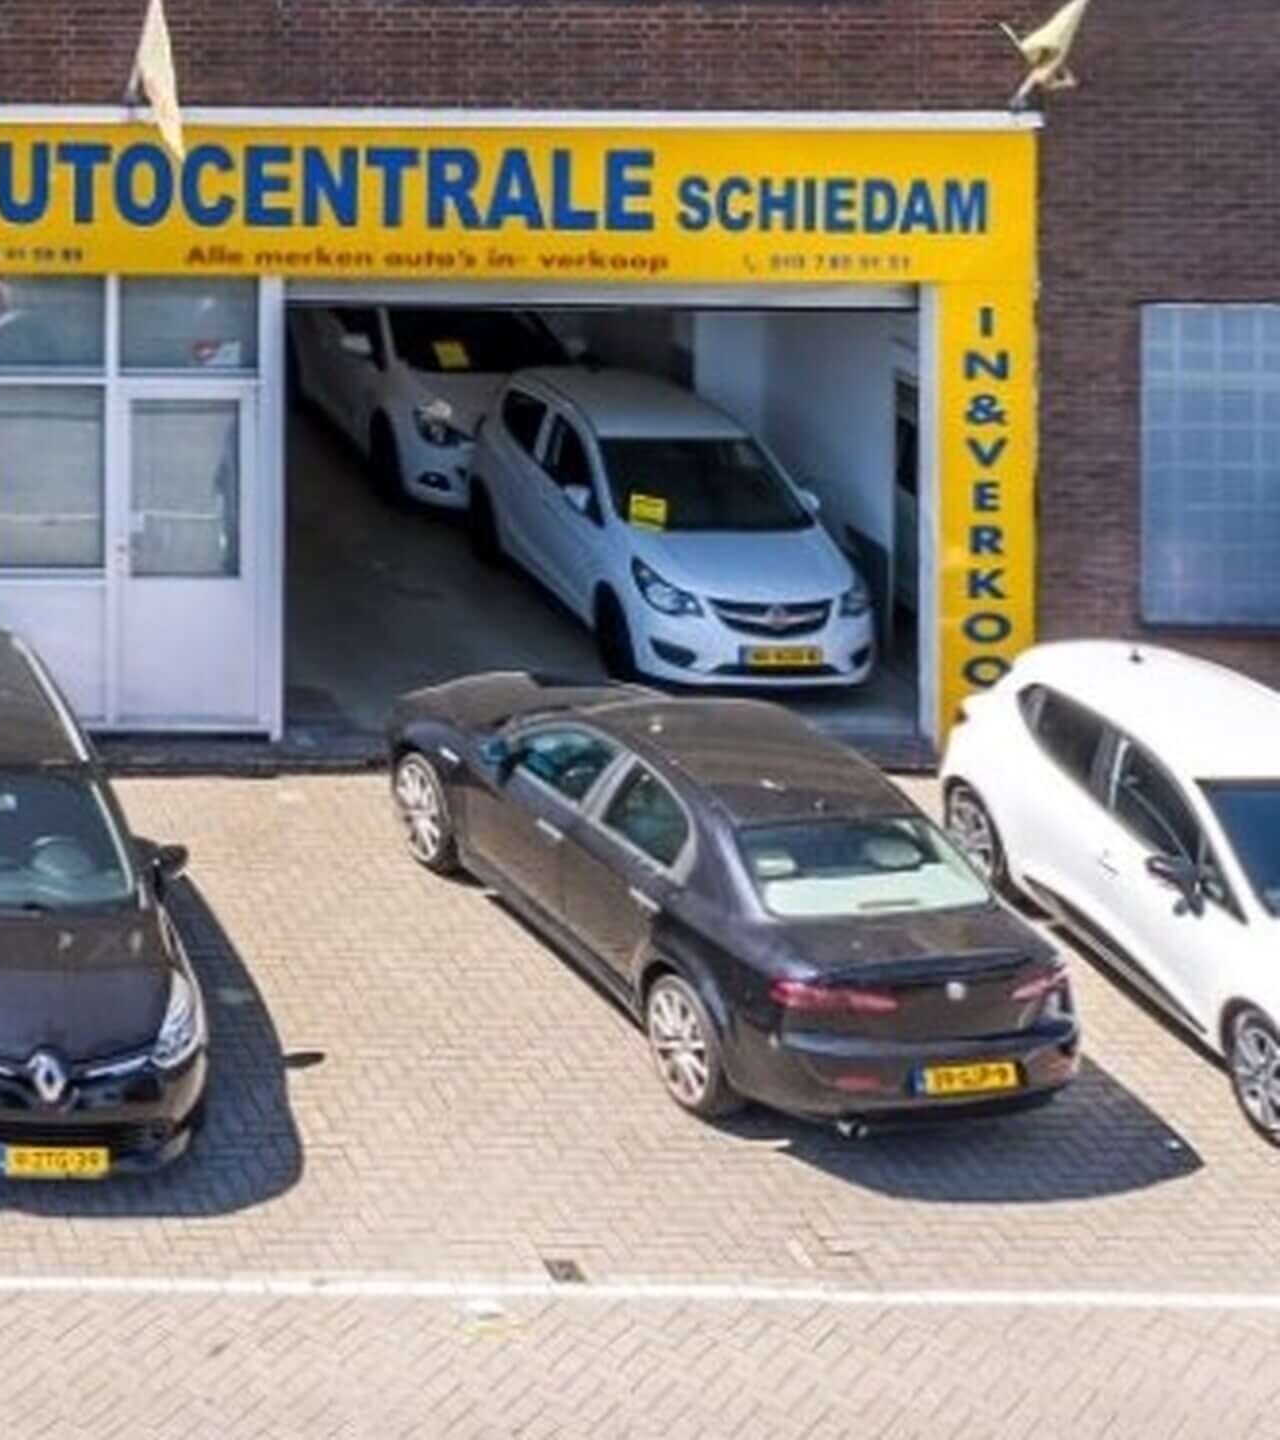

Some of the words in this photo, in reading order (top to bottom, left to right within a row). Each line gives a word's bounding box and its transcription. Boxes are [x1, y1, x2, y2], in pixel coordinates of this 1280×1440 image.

[677, 175, 988, 234] SCHIEDAM
[186, 245, 243, 266] Alle
[255, 247, 373, 267] merken
[383, 247, 477, 268] auto's
[540, 249, 669, 272] verkoop
